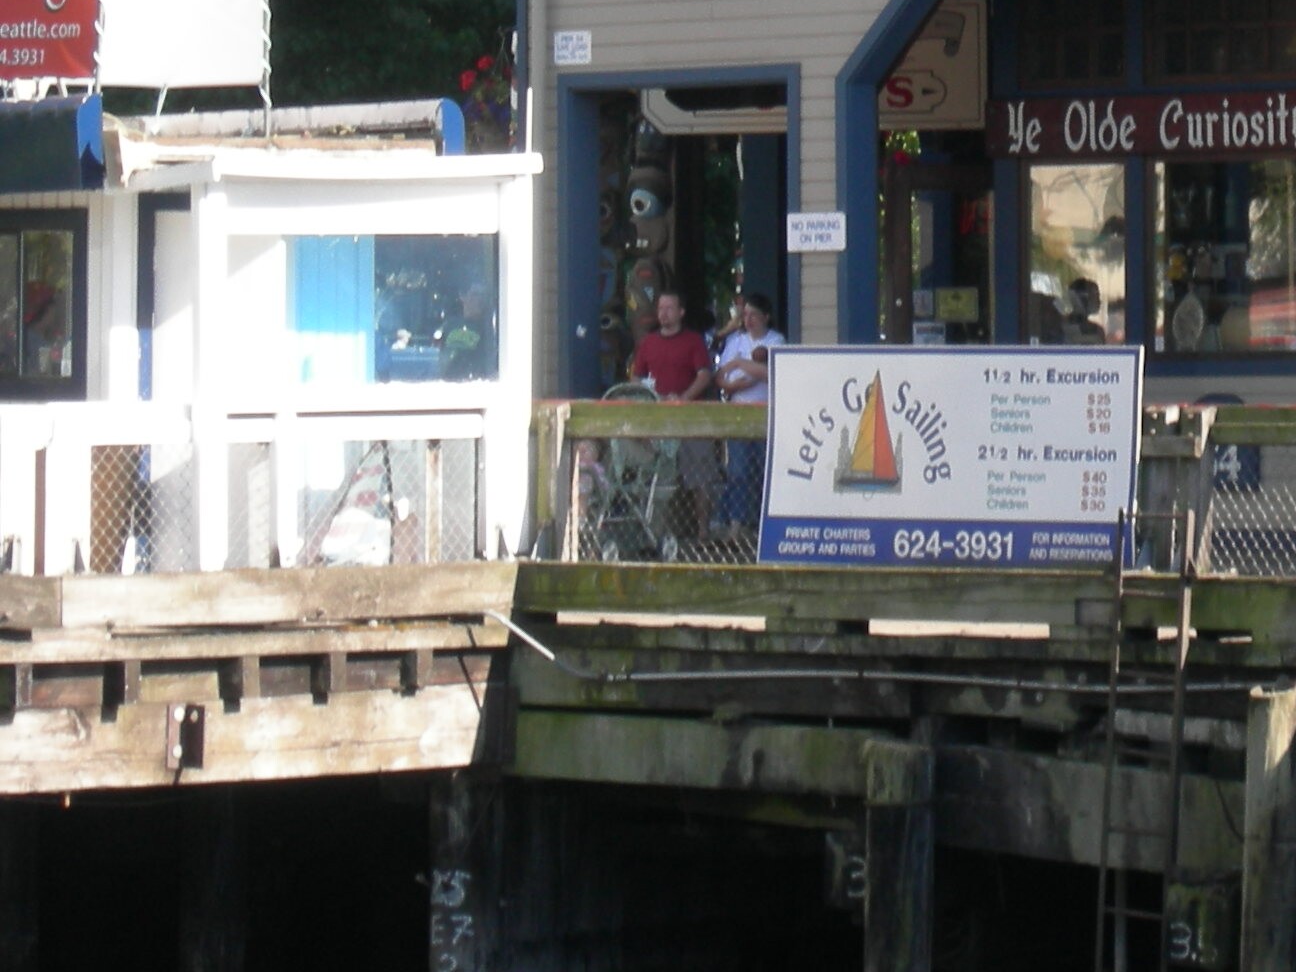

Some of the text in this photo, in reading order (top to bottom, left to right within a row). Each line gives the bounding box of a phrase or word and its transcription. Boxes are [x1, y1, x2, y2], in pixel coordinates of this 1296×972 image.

[1007, 101, 1042, 154] Ye
[1064, 99, 1137, 153] Olde
[1019, 368, 1041, 384] hr.
[1046, 368, 1120, 384] Excursion
[1013, 394, 1051, 406] Person
[787, 407, 835, 480] Let's
[892, 380, 952, 483] Sailing
[1017, 444, 1038, 460] hr.
[1043, 445, 1117, 461] Excursion
[785, 526, 871, 541] PRIVATE CHARTERS
[1033, 532, 1110, 546] FOR INFORMATION
[778, 541, 875, 556] GROUPS AND PARTIES
[893, 529, 1013, 560] 624-3931
